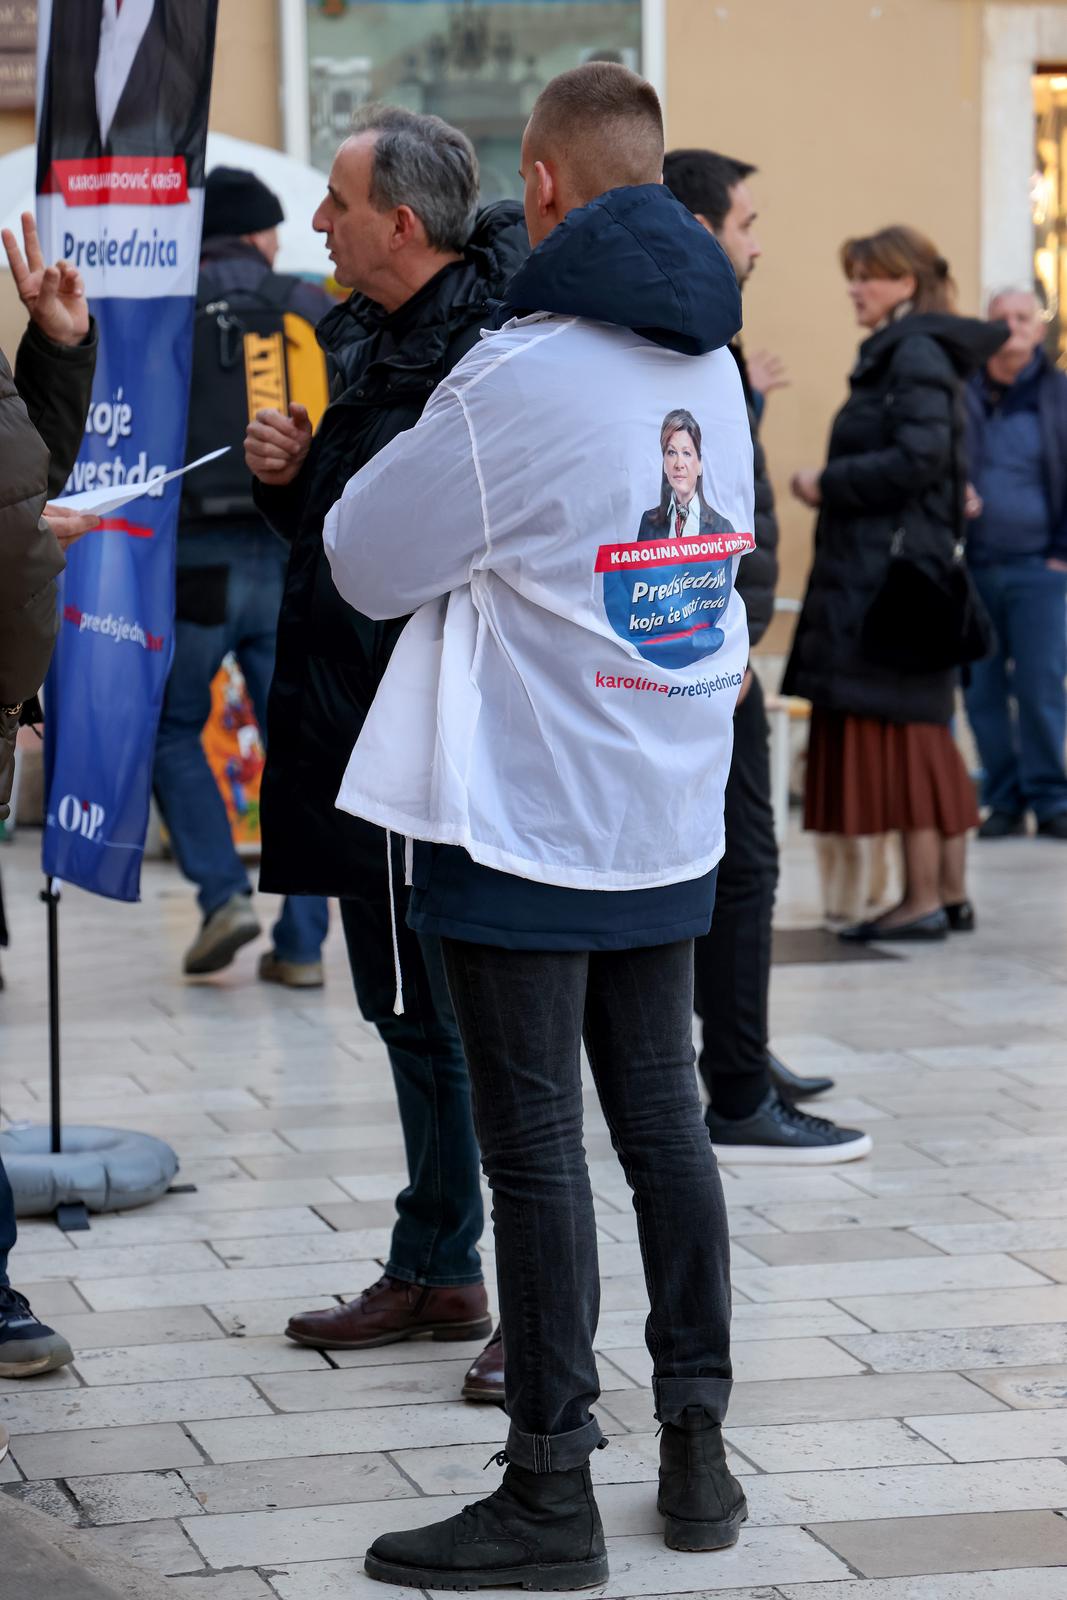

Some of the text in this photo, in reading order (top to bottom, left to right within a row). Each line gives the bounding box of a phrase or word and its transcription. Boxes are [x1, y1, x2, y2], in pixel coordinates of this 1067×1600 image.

[610, 544, 680, 564] KAROLINA
[680, 538, 724, 557] VIDOVIĆ
[629, 612, 665, 632] koja
[667, 606, 681, 624] će
[699, 595, 726, 610] reda
[595, 671, 743, 698] karolinapredsjednica
